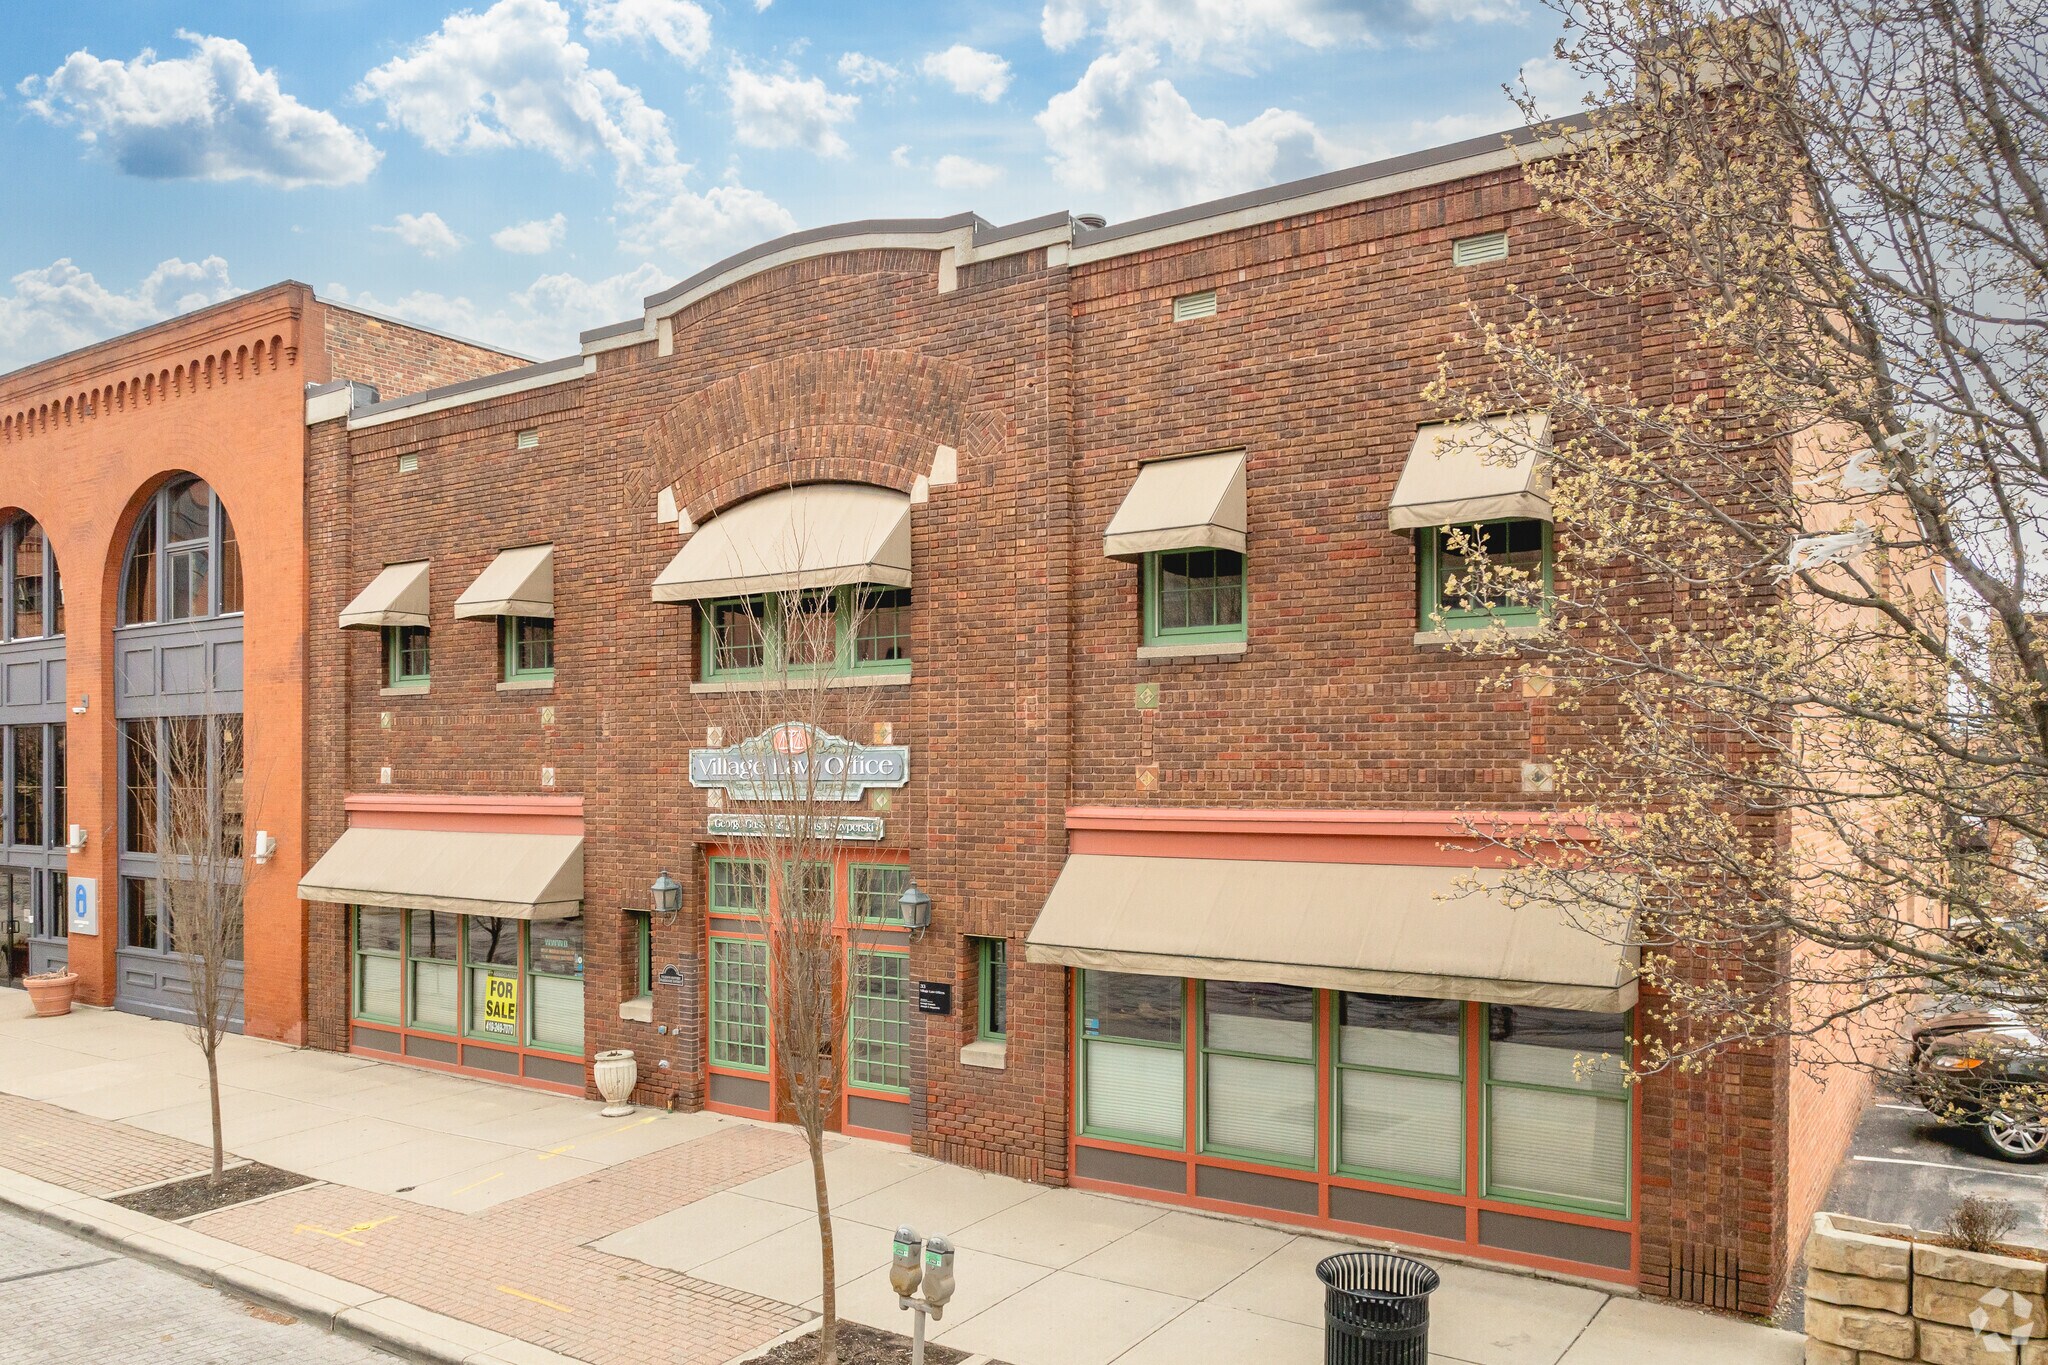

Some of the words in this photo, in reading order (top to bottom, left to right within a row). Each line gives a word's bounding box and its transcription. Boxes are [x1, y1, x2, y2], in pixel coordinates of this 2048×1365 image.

[699, 757, 766, 780] Village
[772, 758, 819, 775] Law
[824, 755, 894, 775] Office
[714, 819, 742, 830] Georg
[490, 980, 513, 999] FOR
[486, 1000, 515, 1020] SALE
